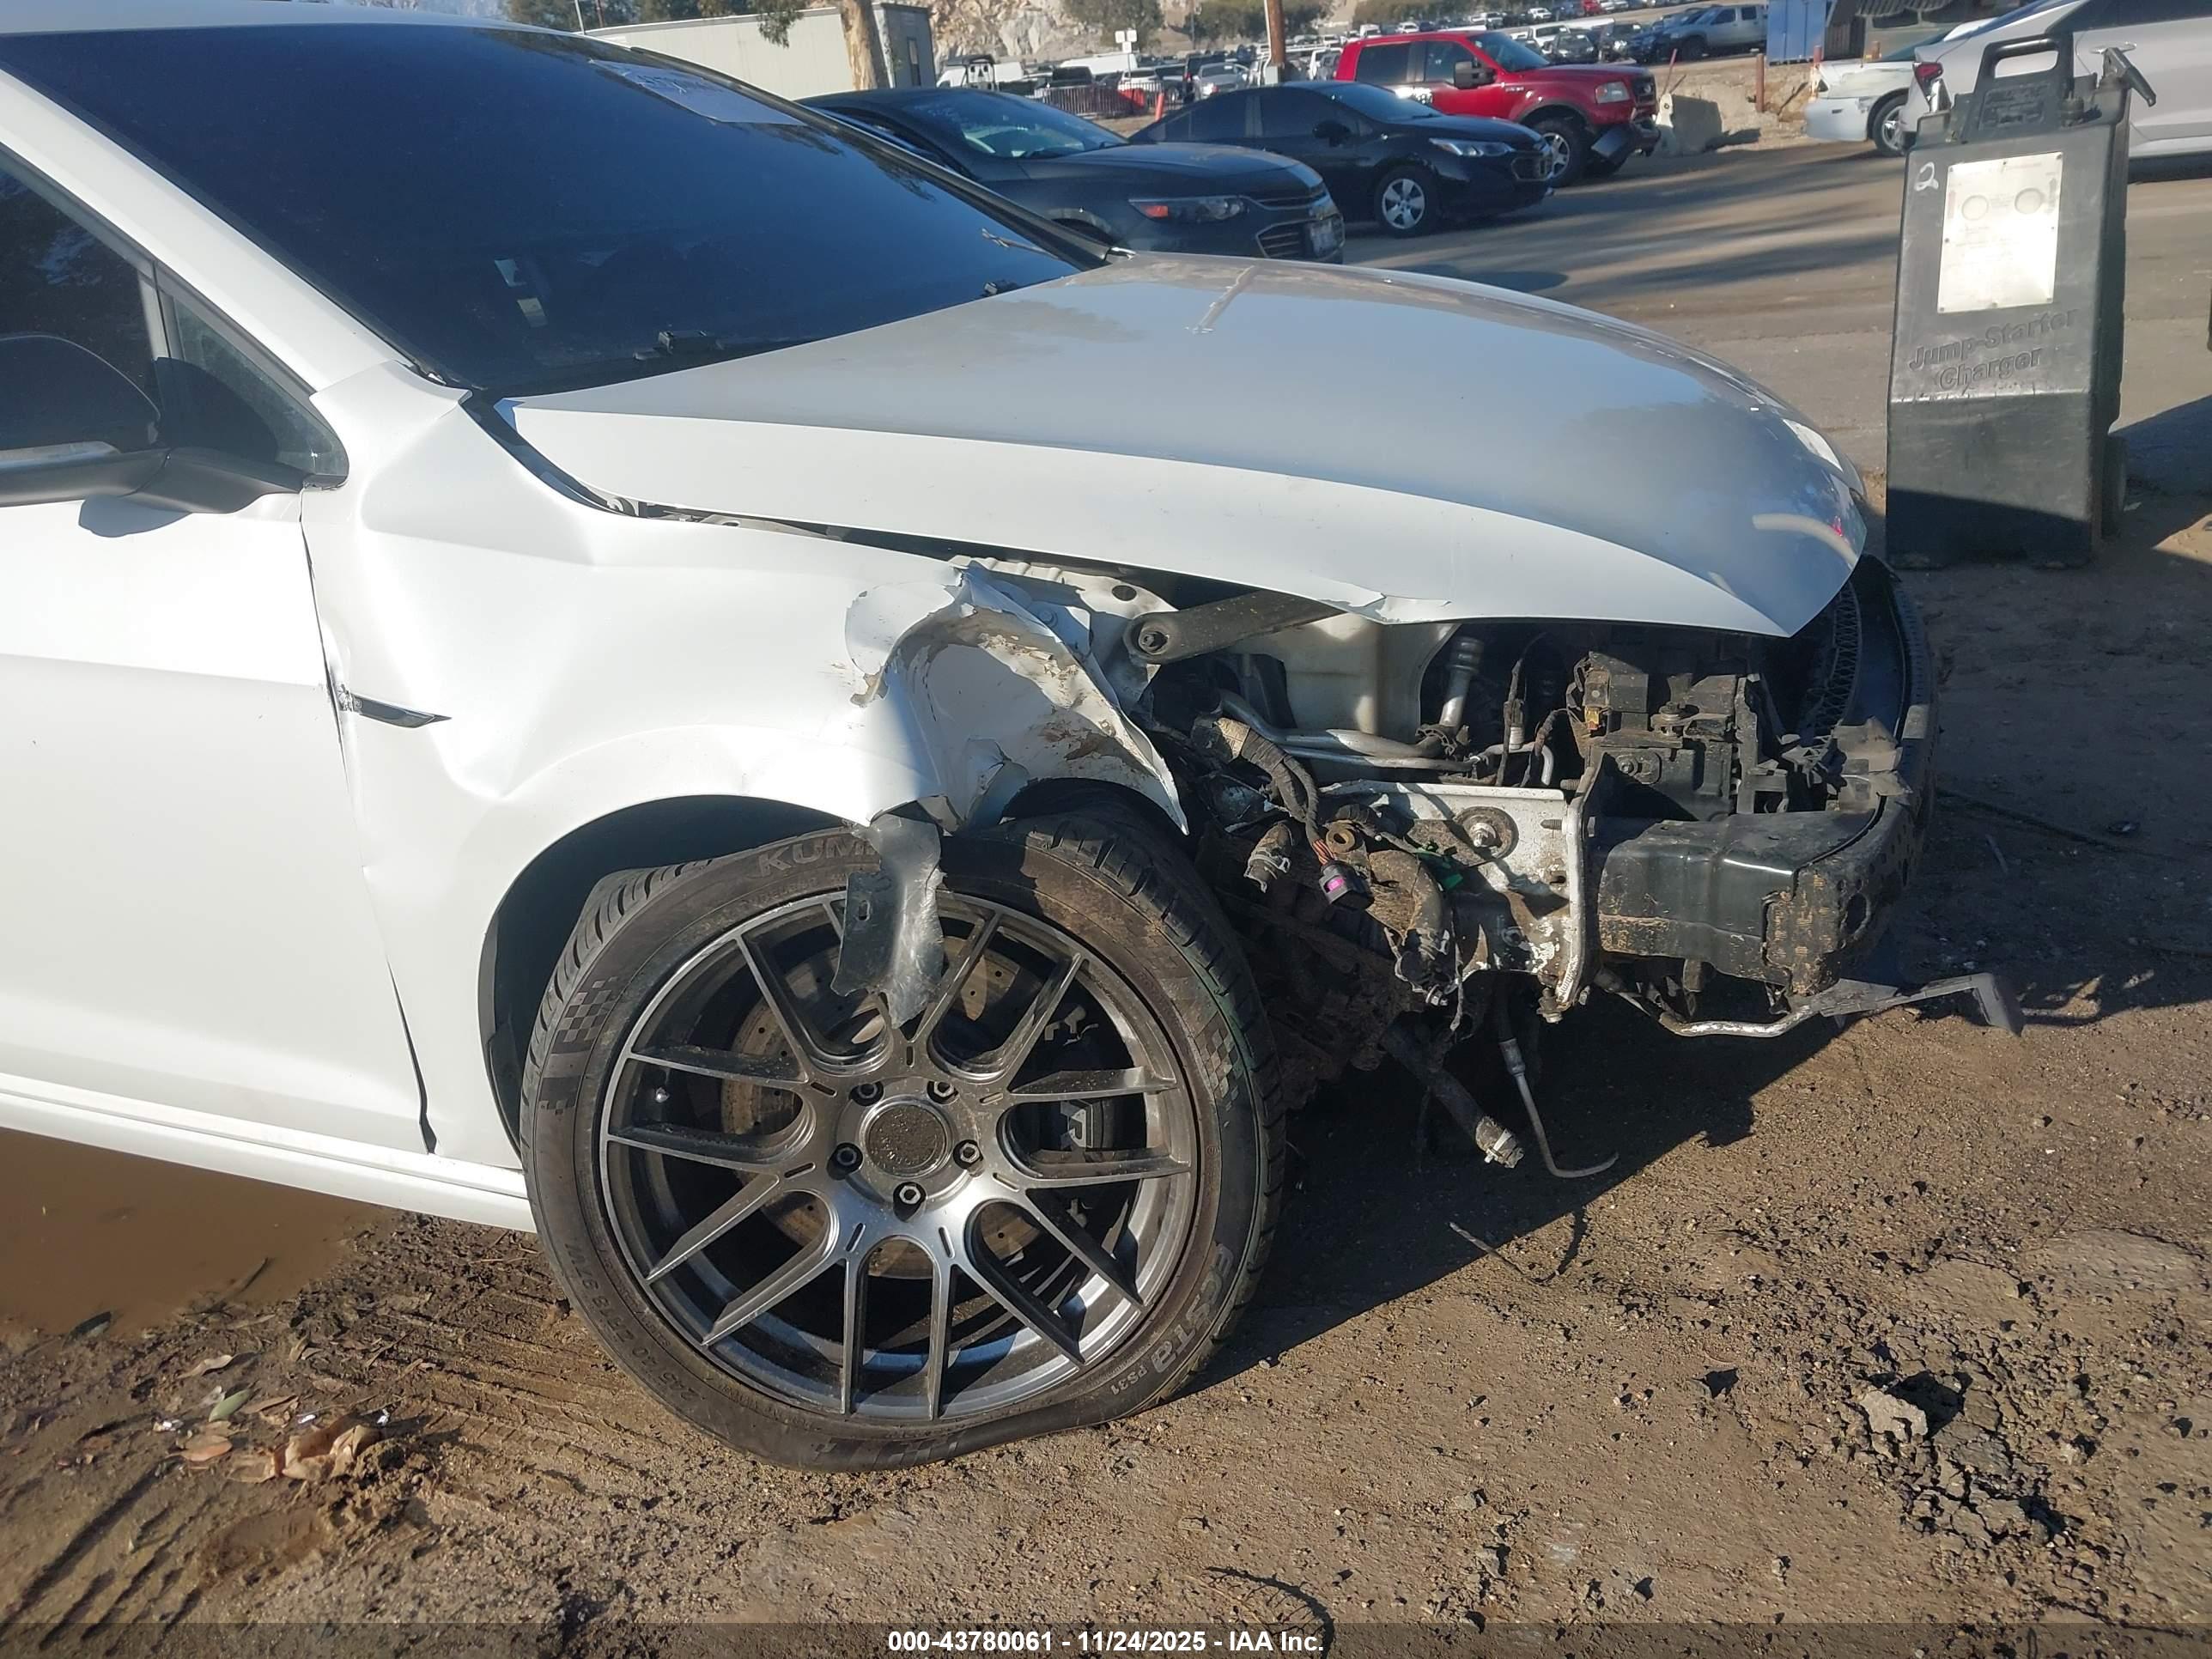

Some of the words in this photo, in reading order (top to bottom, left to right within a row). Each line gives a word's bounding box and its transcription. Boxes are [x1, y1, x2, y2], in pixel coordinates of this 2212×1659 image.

[1914, 161, 1939, 191] 2
[1909, 309, 2079, 371] Jump-Starter
[1939, 348, 2043, 391] Charger
[1110, 1364, 1149, 1396] PS31
